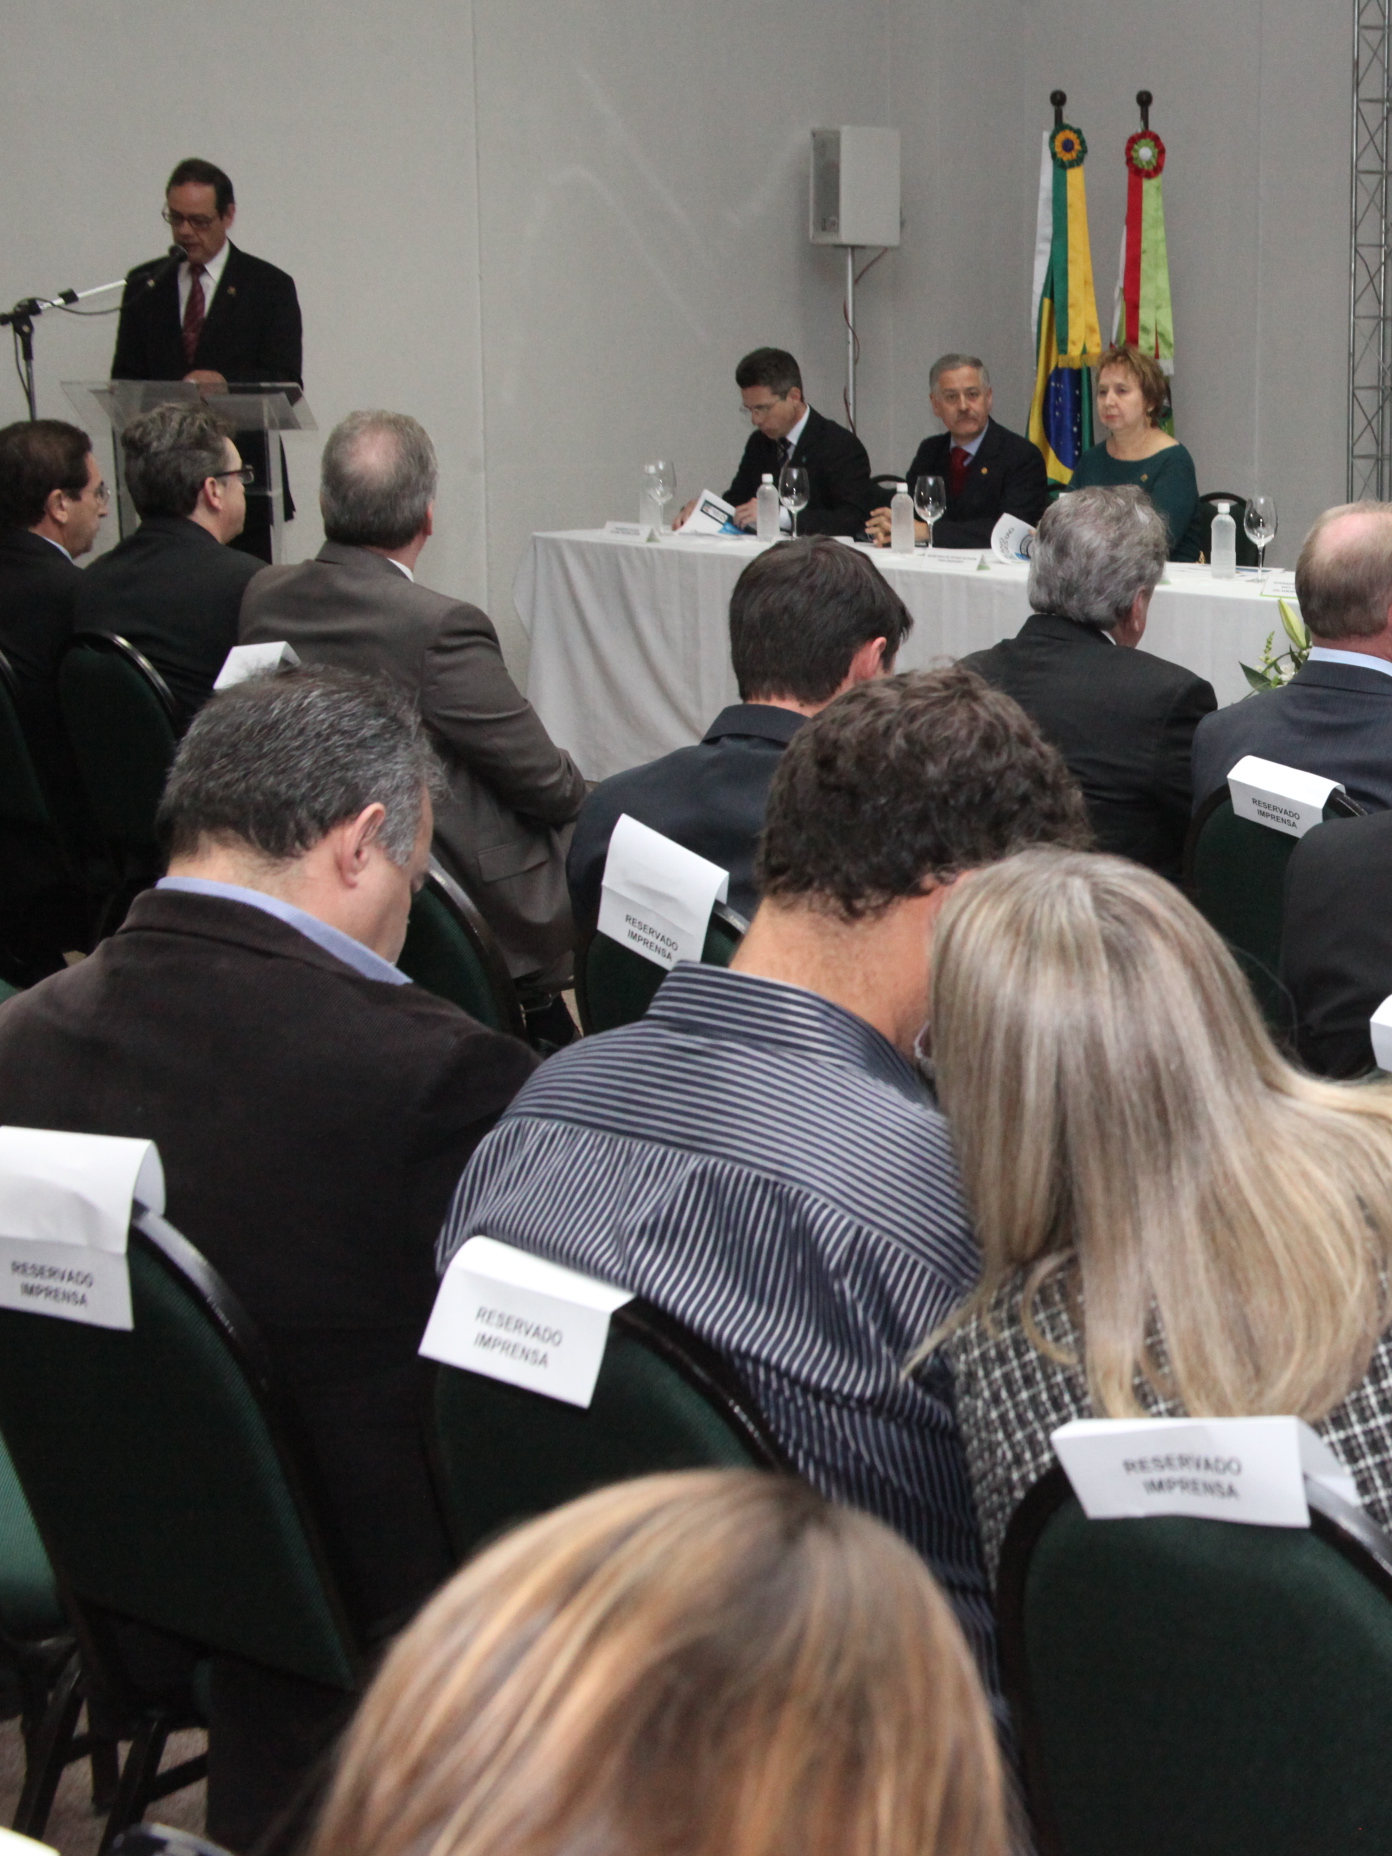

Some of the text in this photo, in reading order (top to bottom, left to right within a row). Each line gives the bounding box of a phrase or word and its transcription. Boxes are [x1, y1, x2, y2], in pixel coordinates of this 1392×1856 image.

[1251, 797, 1300, 820] RESERVADO
[1257, 809, 1297, 828] IMPRENSA
[625, 914, 679, 951] RESERVADO
[627, 929, 672, 961] IMPRENSA
[11, 1261, 94, 1288] RESERVADO
[20, 1282, 87, 1307] IMPRENSA
[475, 1306, 563, 1347] RESERVADO
[474, 1331, 548, 1368] IMPRENSA
[1122, 1453, 1242, 1475] RESERVADO
[1142, 1477, 1240, 1501] IMPRENSA
